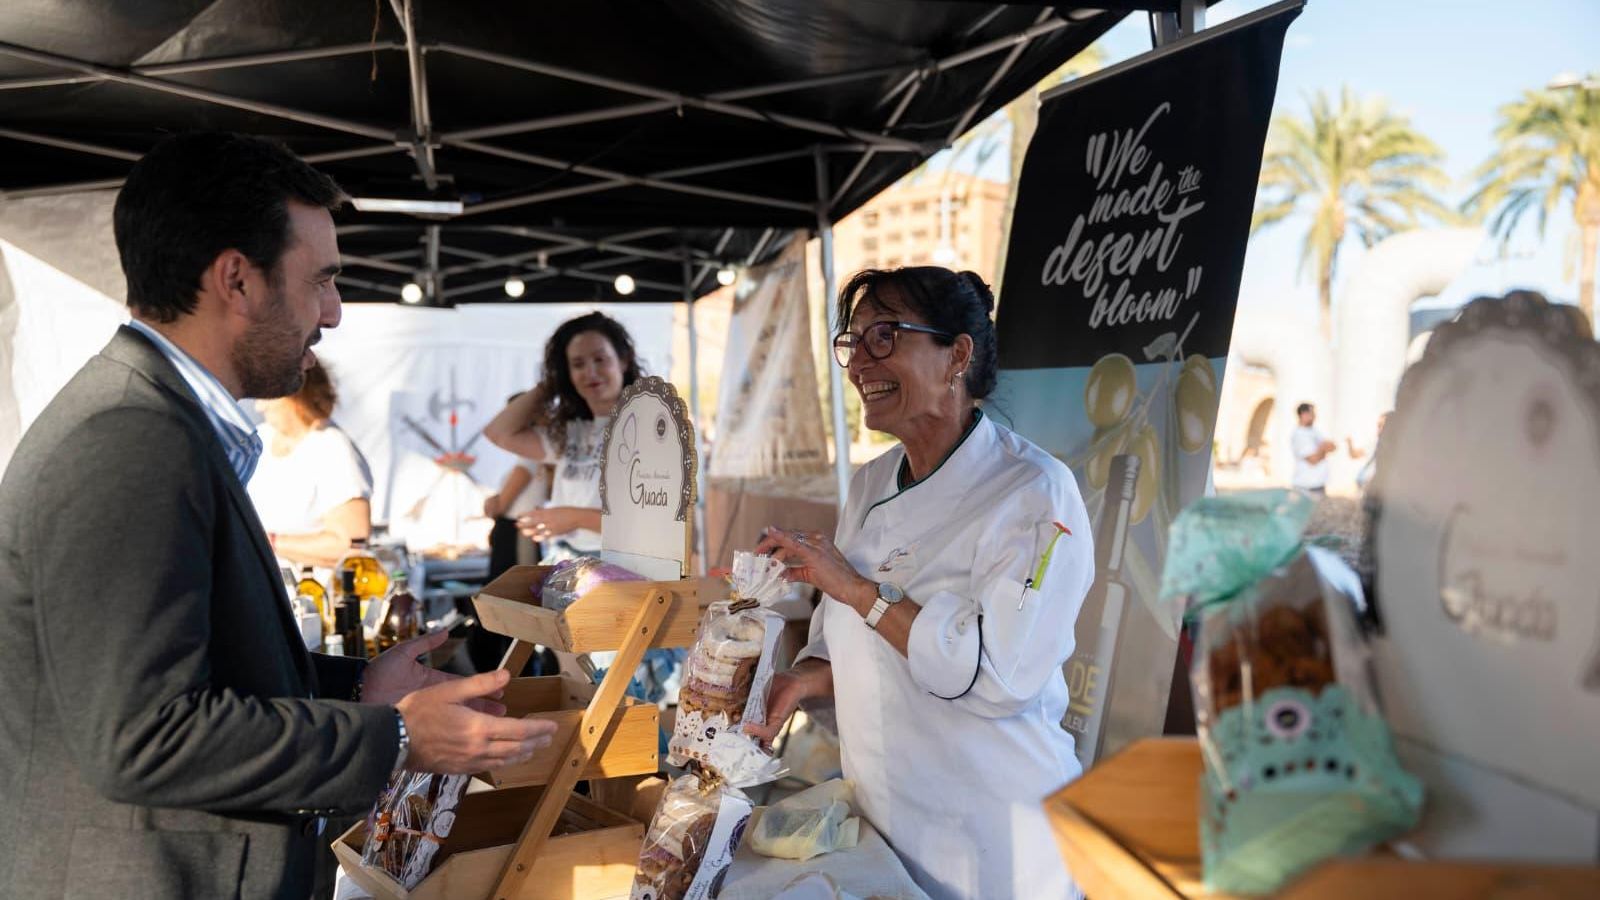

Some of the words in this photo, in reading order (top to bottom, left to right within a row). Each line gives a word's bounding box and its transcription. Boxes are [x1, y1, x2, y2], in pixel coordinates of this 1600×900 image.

[1087, 161, 1175, 225] made
[1177, 165, 1201, 194] the
[1041, 197, 1205, 298] desert
[629, 457, 668, 509] Guada
